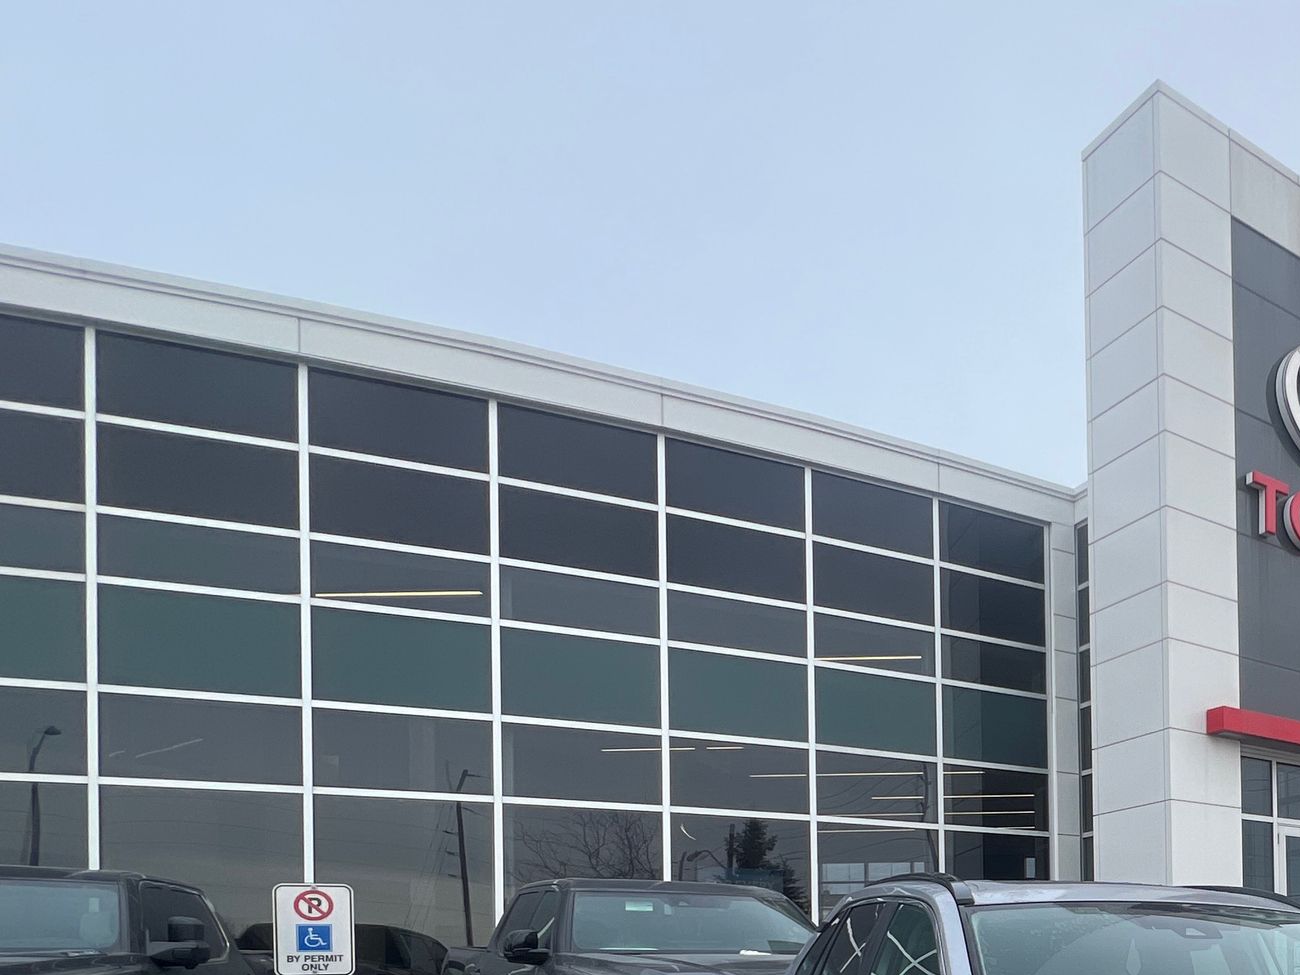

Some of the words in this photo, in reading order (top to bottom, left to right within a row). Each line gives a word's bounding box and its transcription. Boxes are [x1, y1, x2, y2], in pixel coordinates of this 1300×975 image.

[286, 954, 301, 963] BY
[304, 954, 344, 963] PERMIT
[301, 963, 330, 972] ONLY
